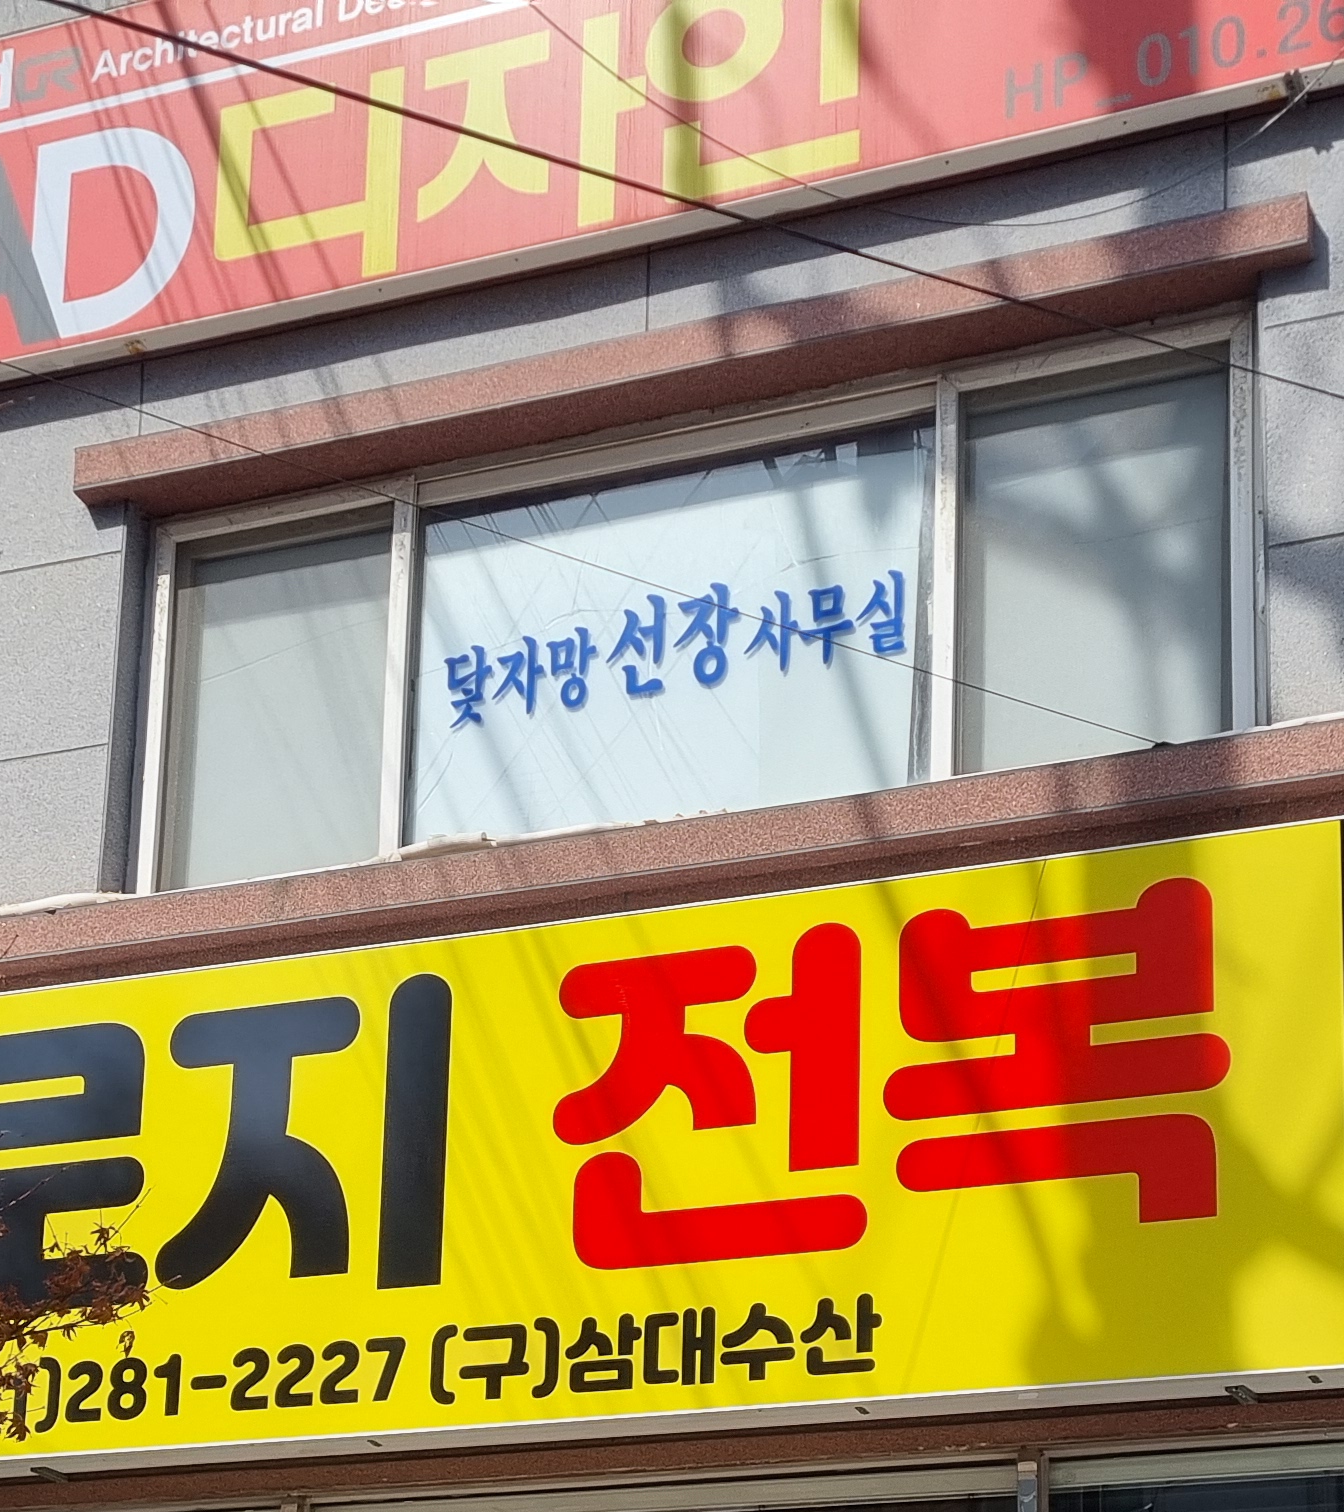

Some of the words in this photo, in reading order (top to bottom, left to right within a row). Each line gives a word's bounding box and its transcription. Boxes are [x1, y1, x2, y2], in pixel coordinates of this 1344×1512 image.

[91, 6, 324, 82] Architectural
[745, 569, 907, 671] 사무실
[553, 877, 1231, 1271] 전복
[430, 1293, 882, 1405] (구)삼대수산
